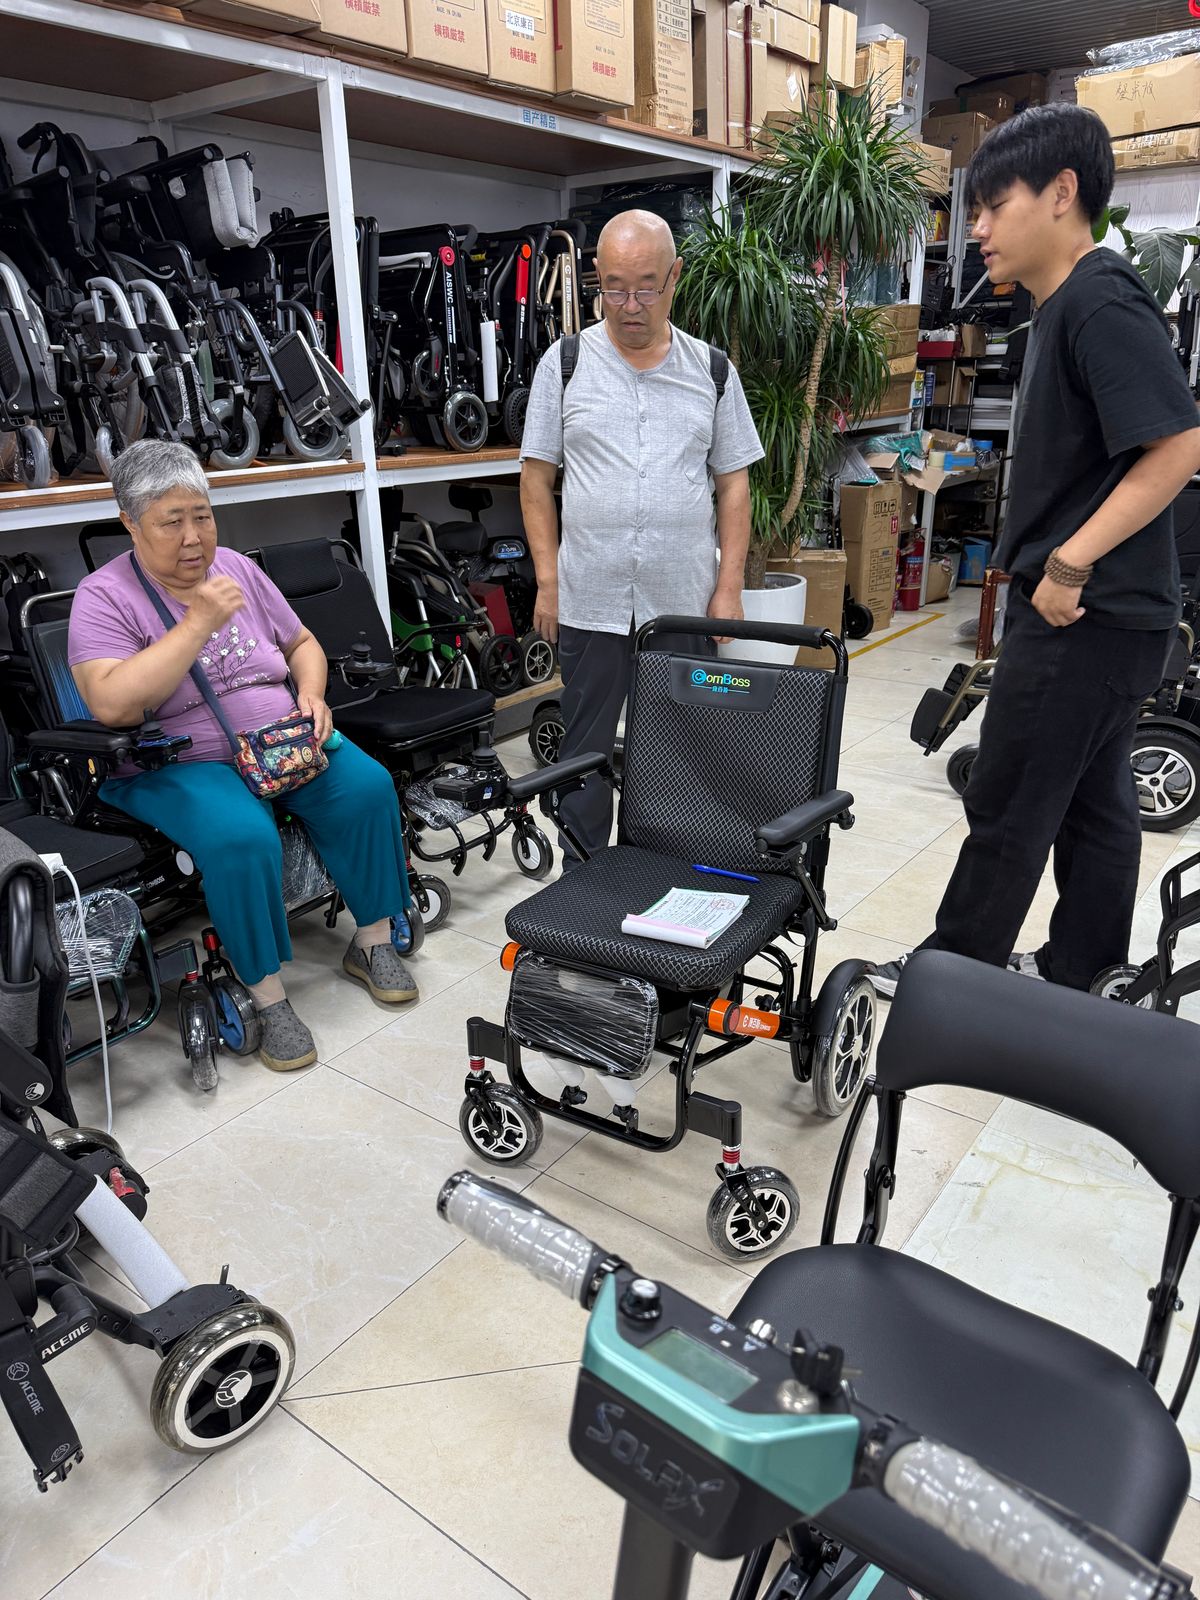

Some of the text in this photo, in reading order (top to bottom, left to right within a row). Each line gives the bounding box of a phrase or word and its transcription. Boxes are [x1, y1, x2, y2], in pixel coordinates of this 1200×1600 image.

[523, 109, 557, 130] 国产精品
[446, 271, 454, 304] AISWC
[41, 1321, 91, 1360] ACEME
[18, 1381, 45, 1416] ACEME
